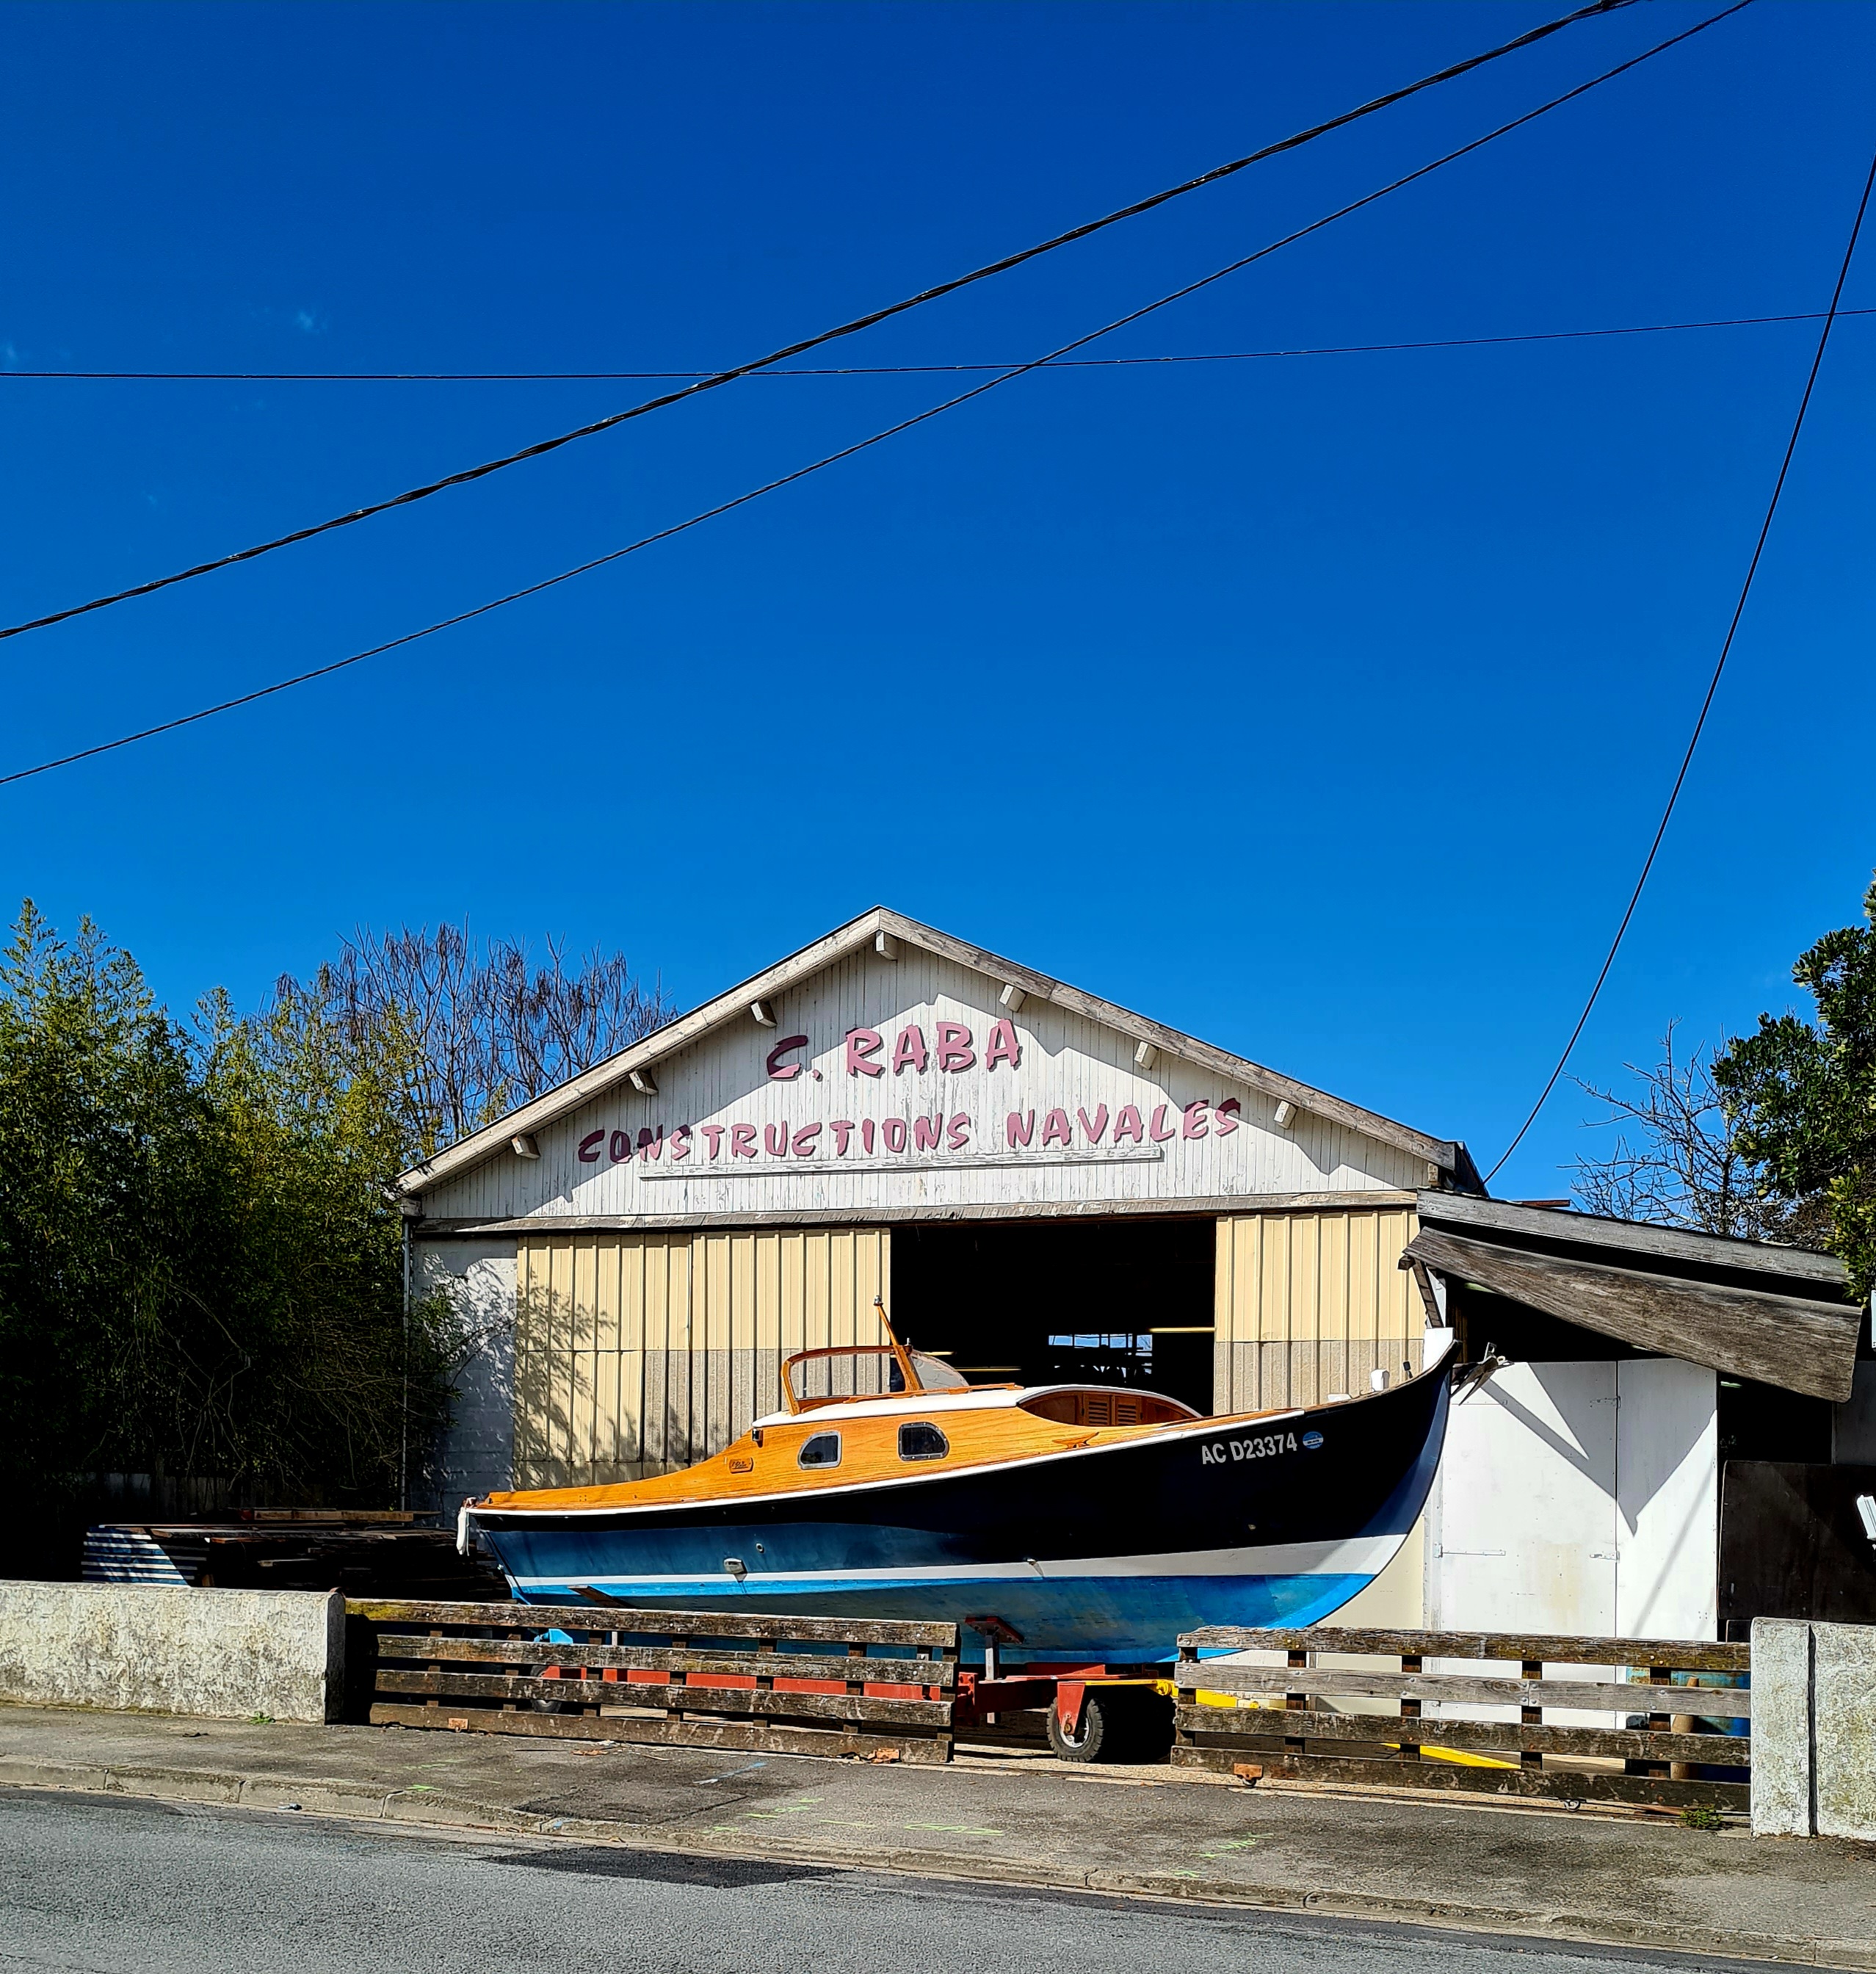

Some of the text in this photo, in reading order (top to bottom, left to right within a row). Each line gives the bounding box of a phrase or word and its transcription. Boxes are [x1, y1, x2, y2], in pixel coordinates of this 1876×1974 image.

[767, 1019, 1021, 1080] C. RABA
[578, 1097, 1242, 1164] CONSTRUCTIONS NAVALES
[1201, 1432, 1297, 1464] AC D23374
